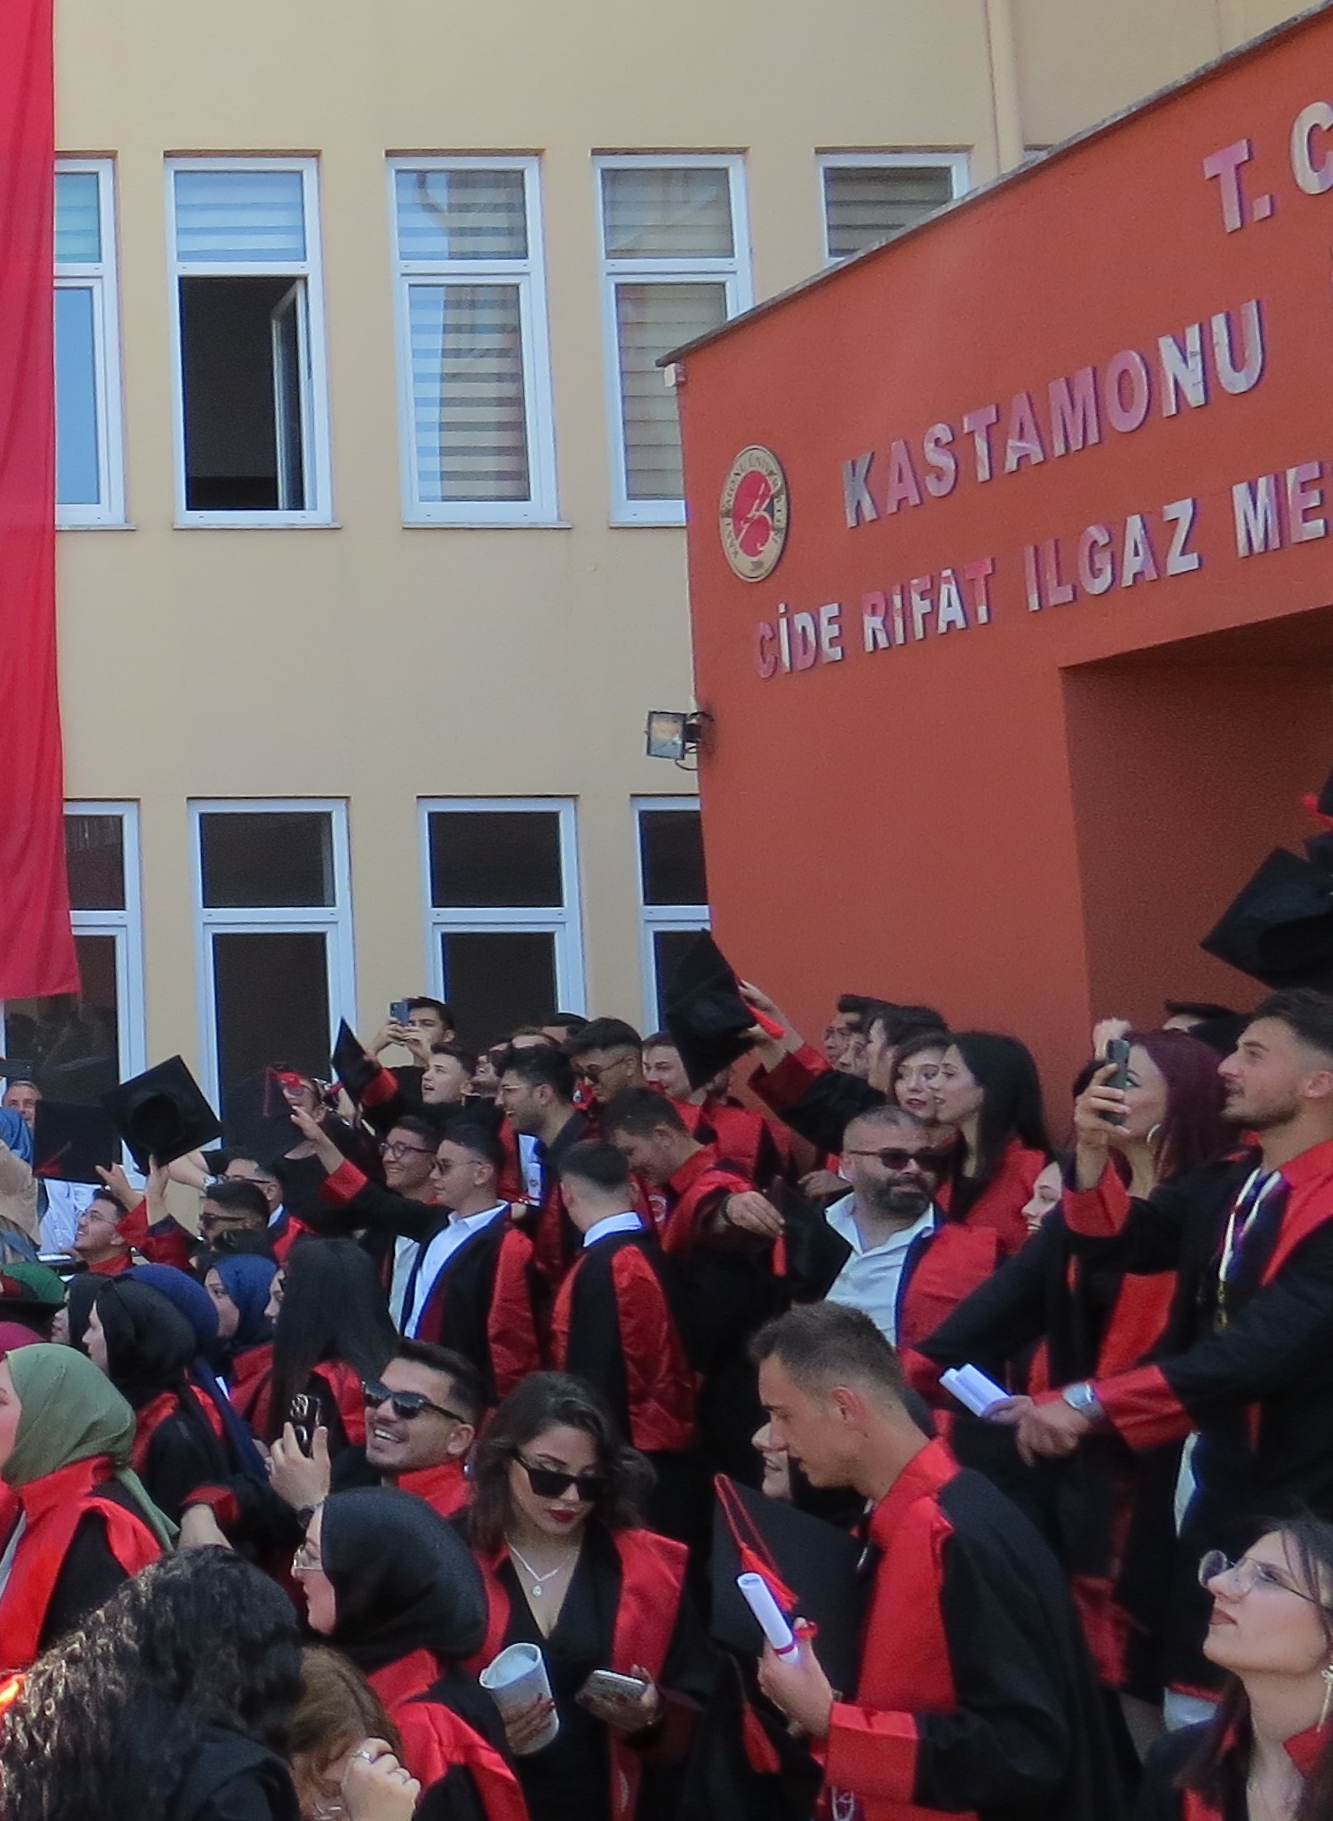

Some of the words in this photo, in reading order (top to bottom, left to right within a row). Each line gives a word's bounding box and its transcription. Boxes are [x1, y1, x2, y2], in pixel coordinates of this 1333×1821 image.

[1203, 138, 1273, 233] T.
[842, 300, 1263, 528] KASTAMONU
[755, 602, 843, 680] CİDE
[1024, 498, 1201, 612] ILGAZ
